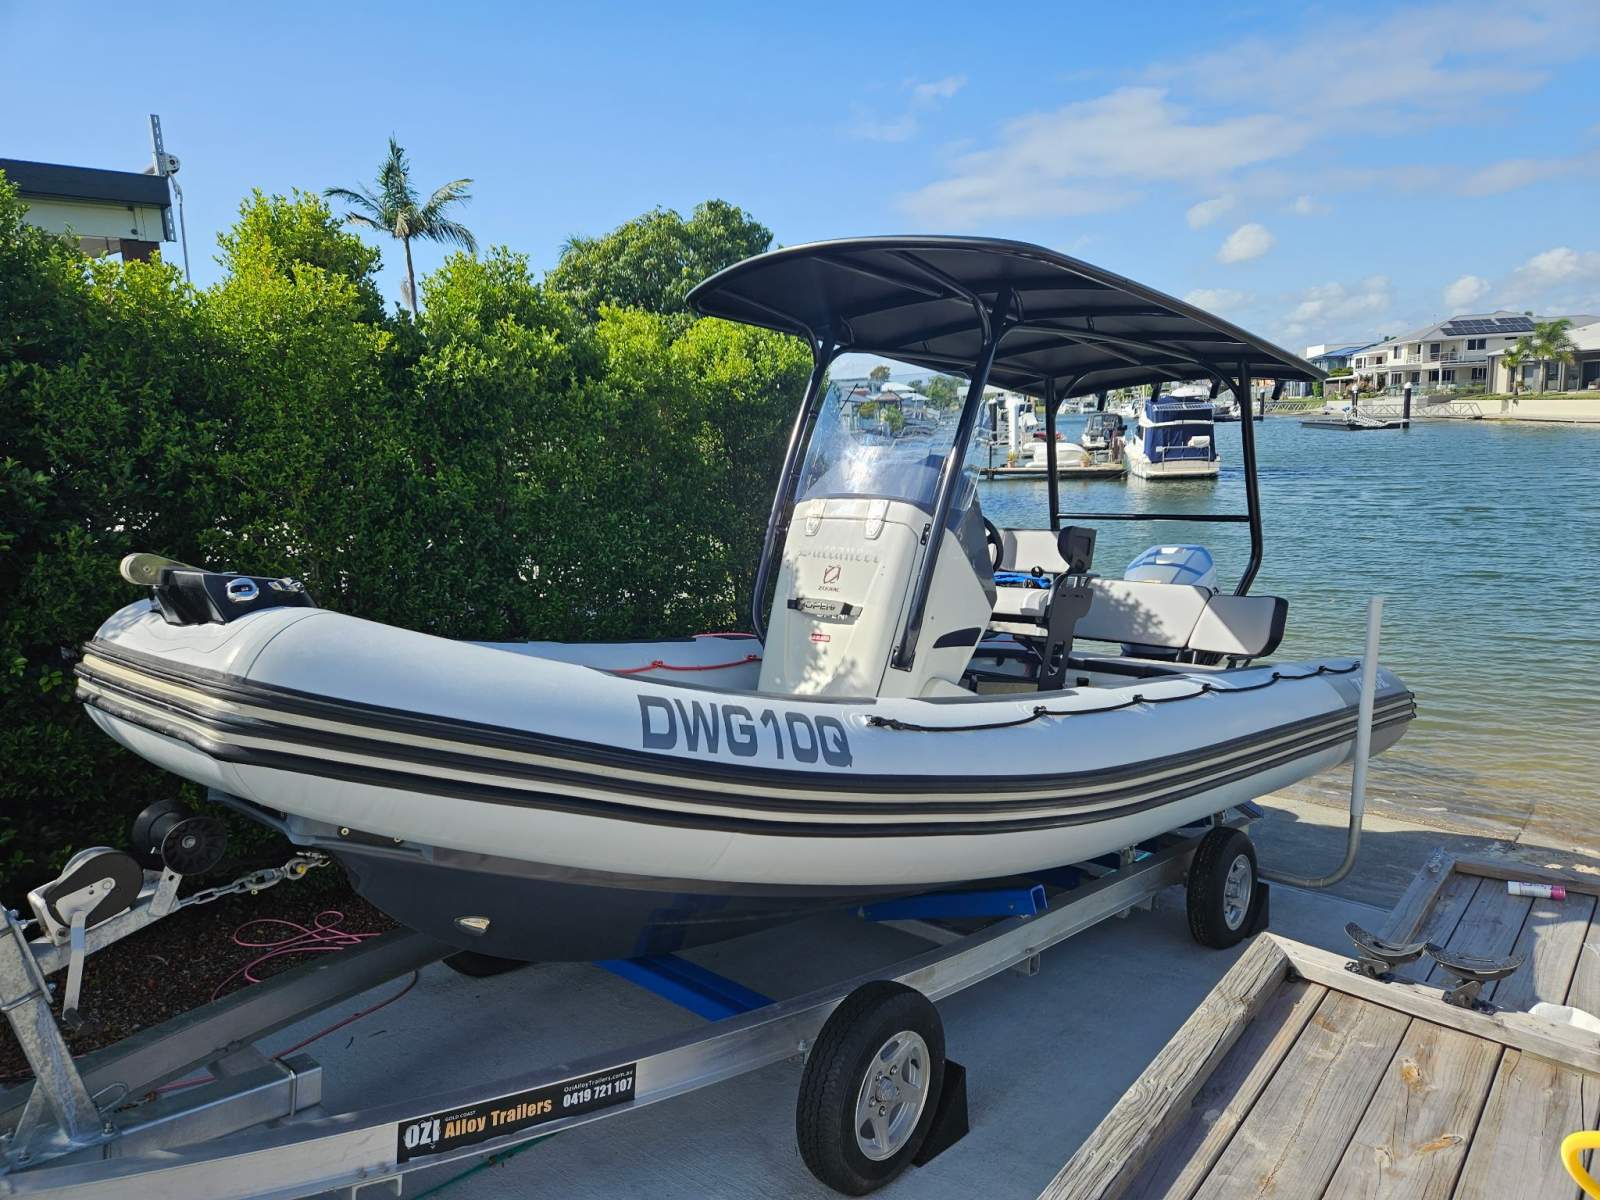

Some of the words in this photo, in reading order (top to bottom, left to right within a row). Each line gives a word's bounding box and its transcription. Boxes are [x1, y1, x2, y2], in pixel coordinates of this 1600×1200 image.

[637, 694, 853, 768] DWG10Q
[563, 1088, 592, 1108] 0419
[594, 1082, 613, 1100] 721
[615, 1076, 633, 1094] 107
[444, 1114, 487, 1140] Alloy
[490, 1098, 553, 1127] Trailers
